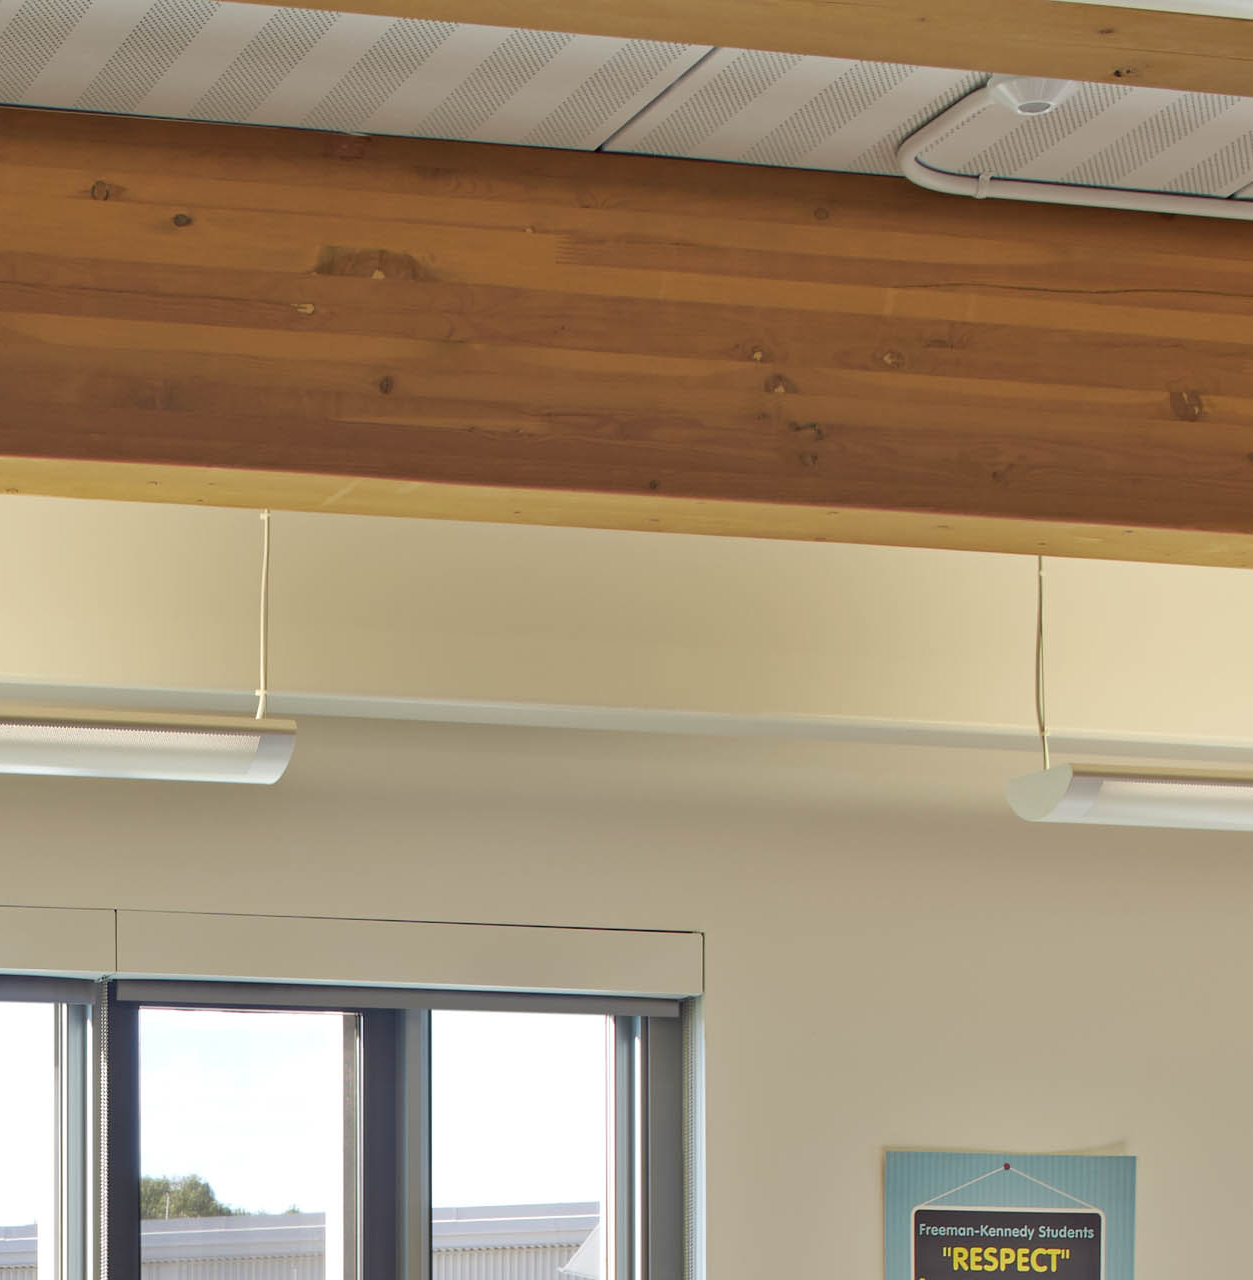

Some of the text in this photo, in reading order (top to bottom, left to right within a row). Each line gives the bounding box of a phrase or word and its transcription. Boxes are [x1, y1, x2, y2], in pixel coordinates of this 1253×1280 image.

[919, 1223, 1095, 1240] Freeman-Kennedy Students
[942, 1246, 1070, 1272] "RESPECT"
